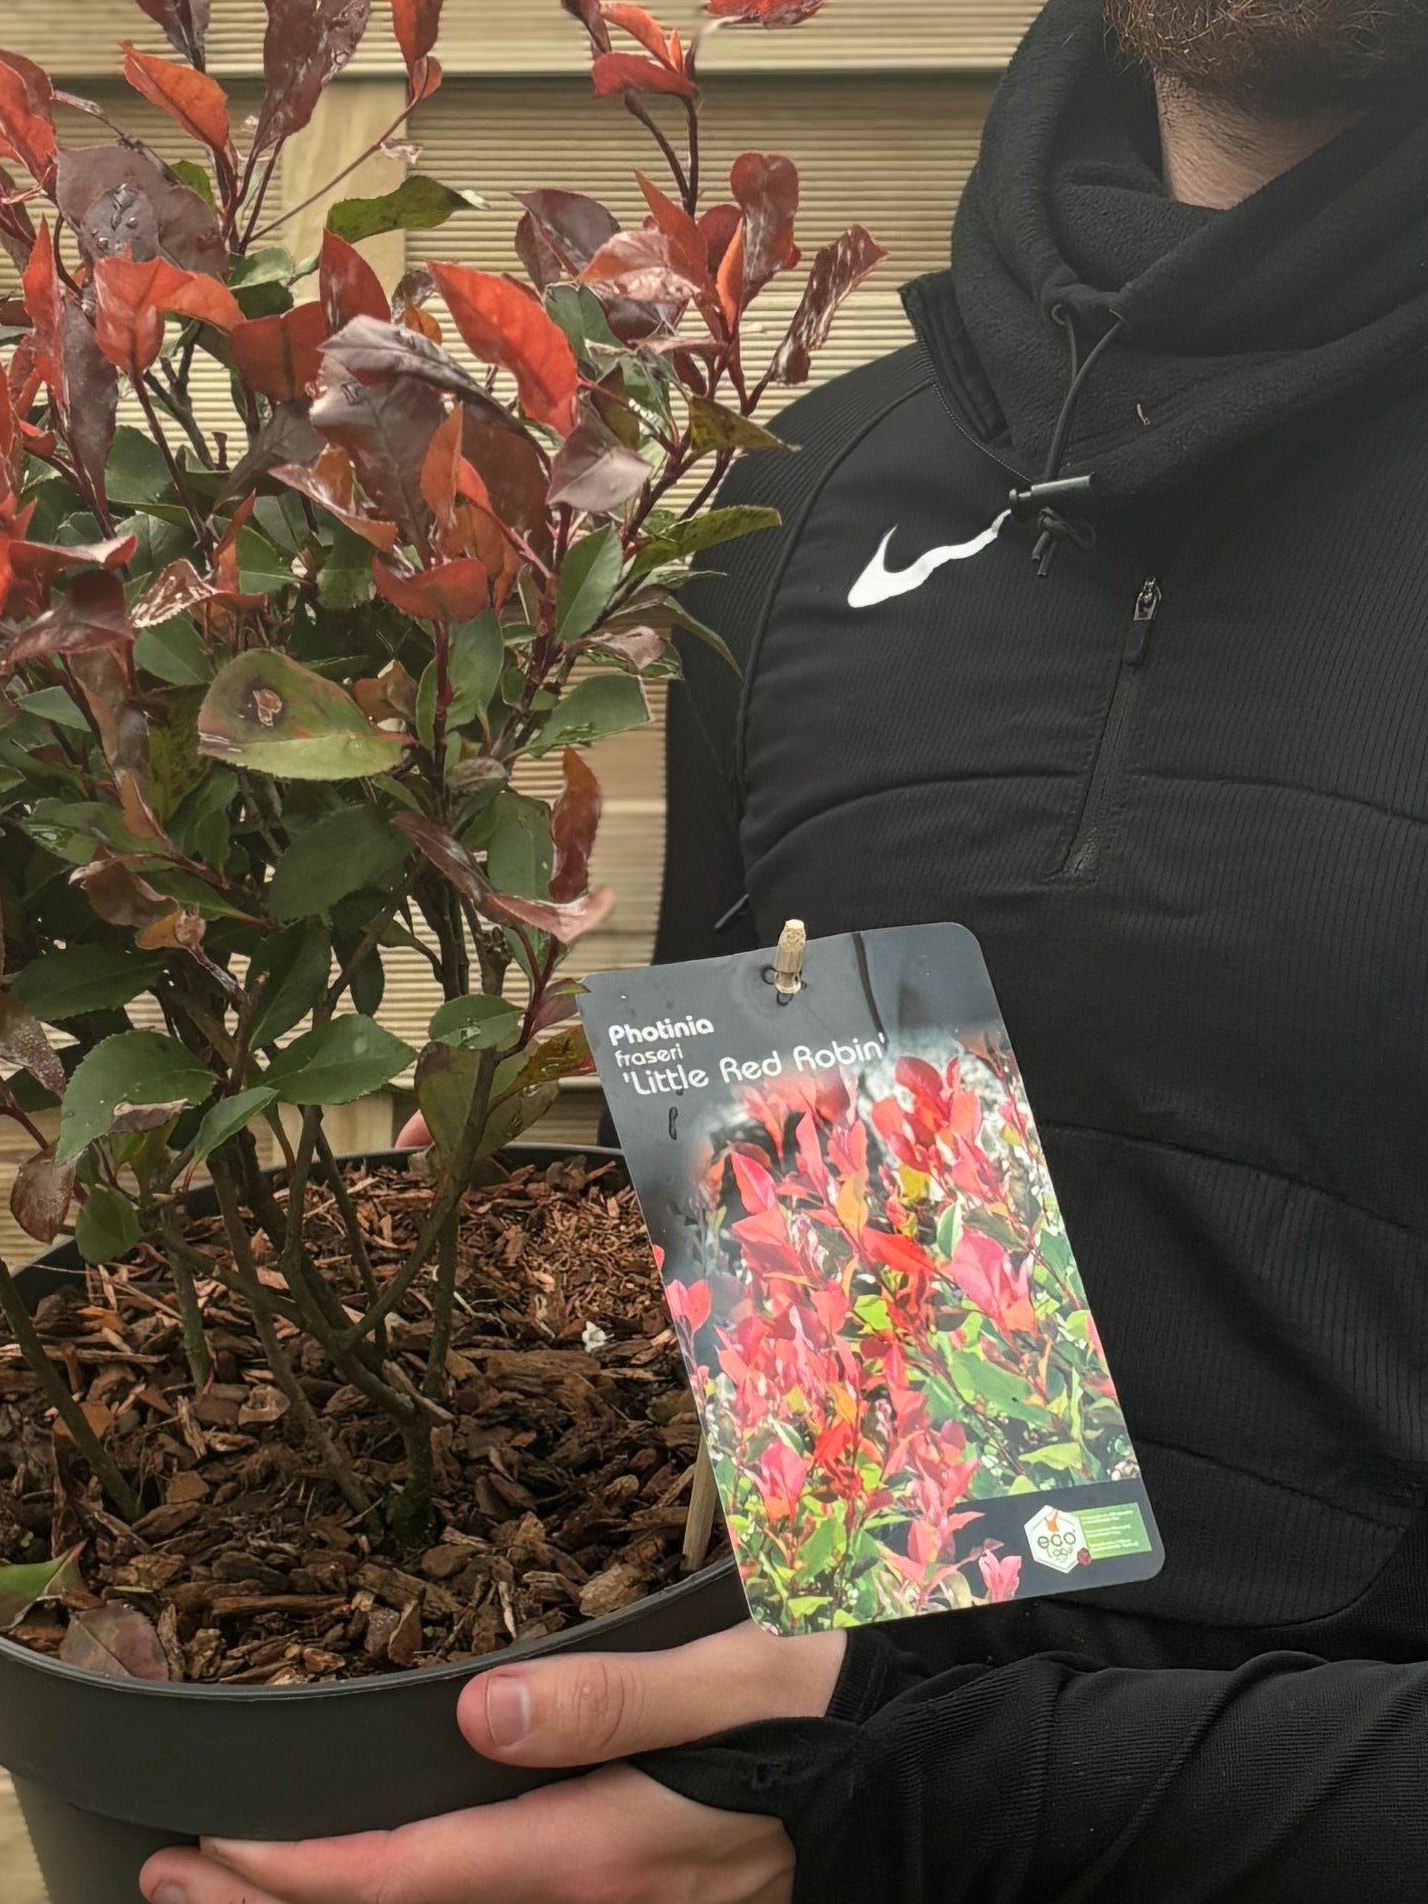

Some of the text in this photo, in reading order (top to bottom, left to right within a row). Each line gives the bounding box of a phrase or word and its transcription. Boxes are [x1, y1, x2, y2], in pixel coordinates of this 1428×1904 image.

[608, 1015, 715, 1047] Photinia
[614, 1043, 684, 1068] fraseri
[622, 1032, 886, 1095] 'Little Red Robin'
[1037, 1531, 1077, 1549] eco
